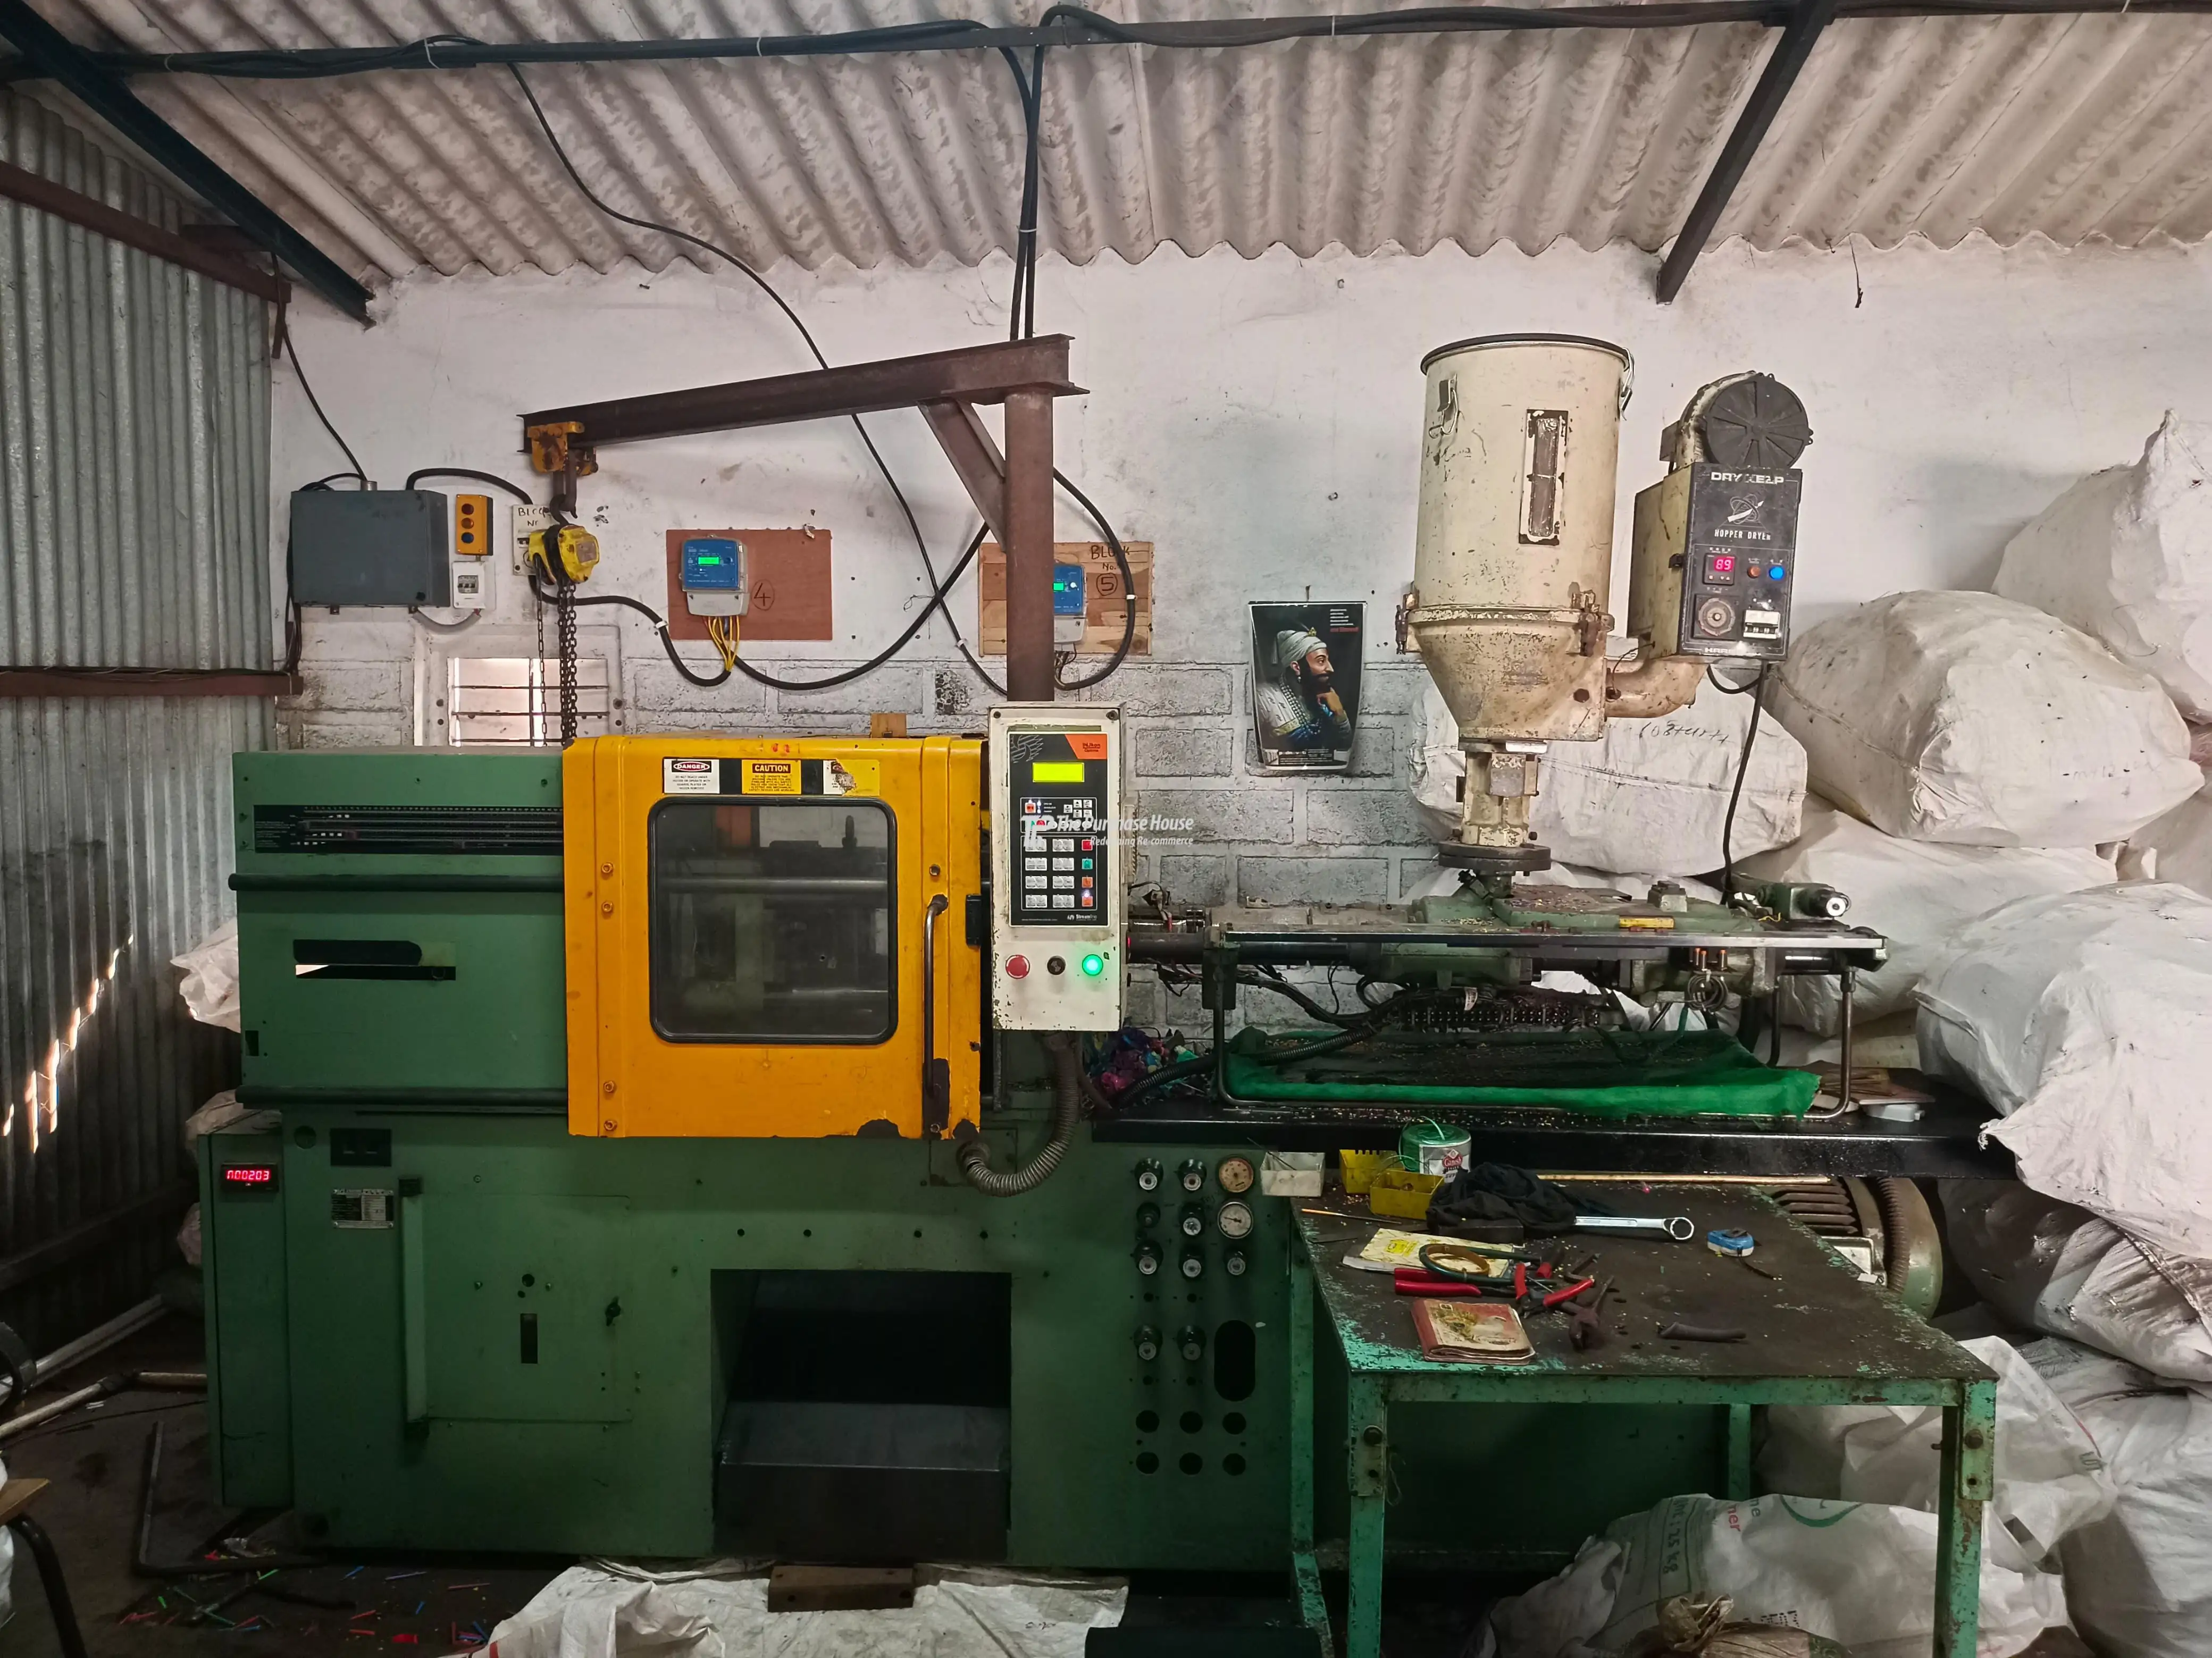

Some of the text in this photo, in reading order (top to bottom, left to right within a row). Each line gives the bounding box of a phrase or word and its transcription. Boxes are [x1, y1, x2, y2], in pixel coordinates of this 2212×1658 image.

[1714, 529, 1743, 538] HOPPER
[1091, 545, 1130, 560] BLOK
[1715, 559, 1732, 570] 89
[1101, 576, 1114, 591] 5
[753, 583, 771, 606] 4
